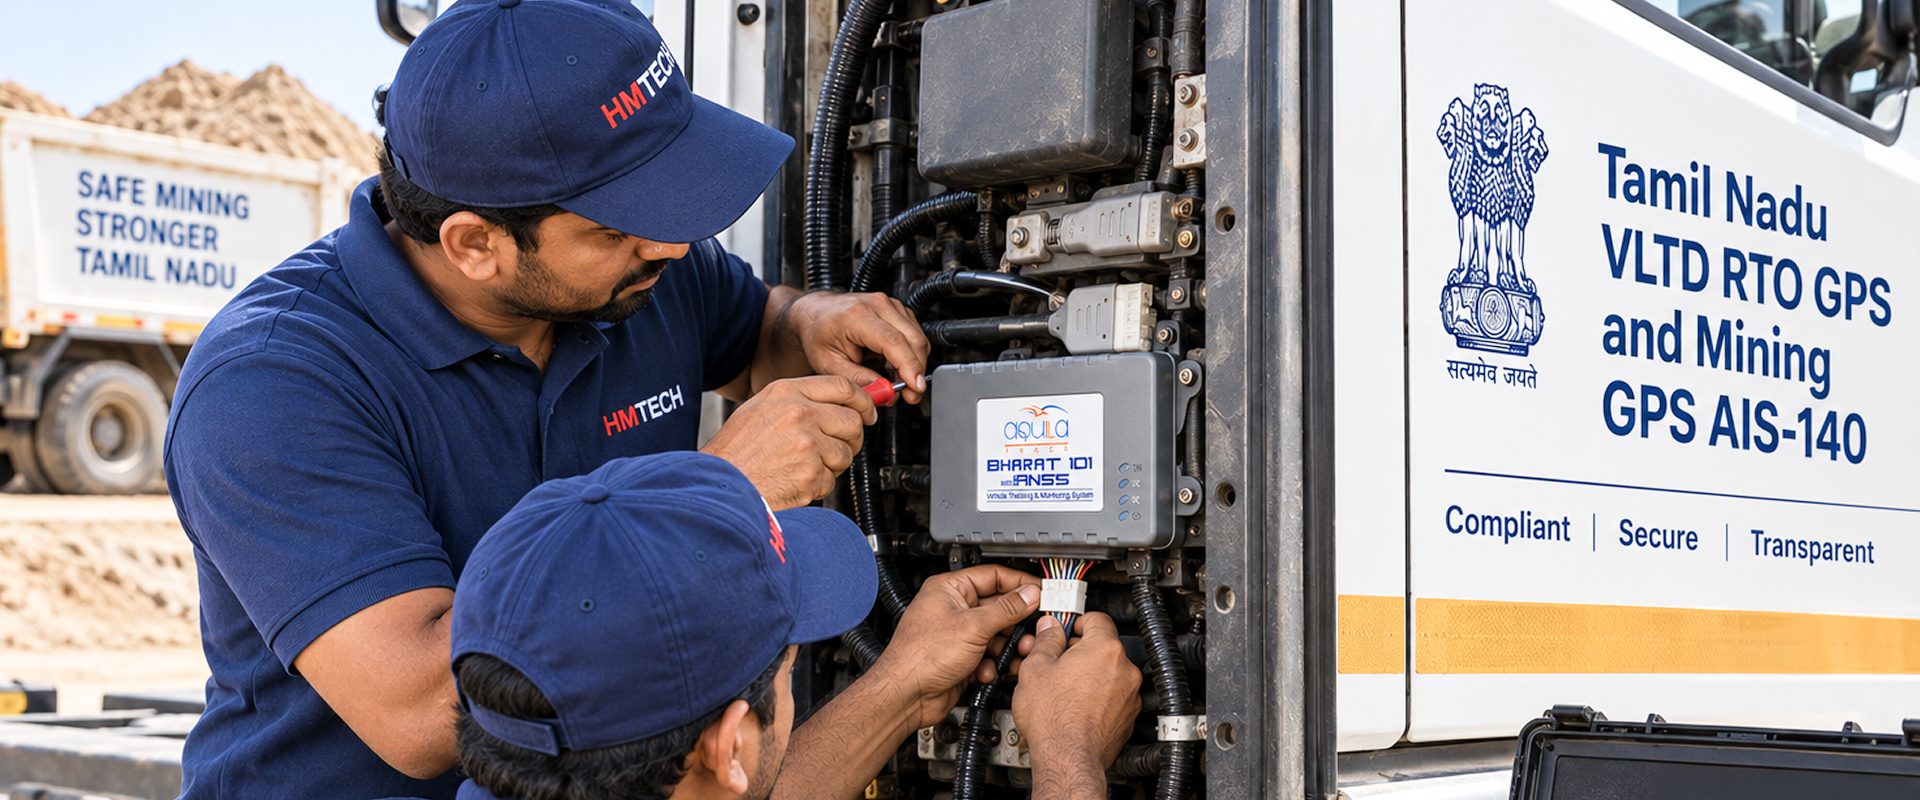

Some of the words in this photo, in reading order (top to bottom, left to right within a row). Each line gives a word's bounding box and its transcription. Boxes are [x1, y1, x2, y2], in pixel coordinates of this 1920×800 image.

[600, 41, 675, 128] HMTECH
[78, 171, 145, 206] SAFE
[155, 182, 250, 220] MINING
[1598, 142, 1711, 219] Tamil
[1726, 170, 1828, 242] Nadu
[77, 208, 219, 251] STRONGER
[77, 247, 155, 281] TAMIL
[165, 257, 236, 290] NADU
[1601, 223, 1710, 293] VLTD
[1723, 246, 1803, 311] RTO
[1814, 266, 1892, 328] GPS
[1446, 356, 1498, 384] सत्यमेव
[1502, 363, 1538, 389] जयते
[1602, 310, 1682, 364] and
[1697, 315, 1831, 400] Mining
[602, 384, 685, 437] HMTECH
[1602, 379, 1697, 444] GPS
[1708, 395, 1868, 465] AIS-140
[986, 457, 1061, 472] BHARAT
[1068, 456, 1093, 470] 101
[1445, 504, 1571, 545] Compliant
[1619, 518, 1699, 551] Secure
[1750, 529, 1875, 567] Transparent
